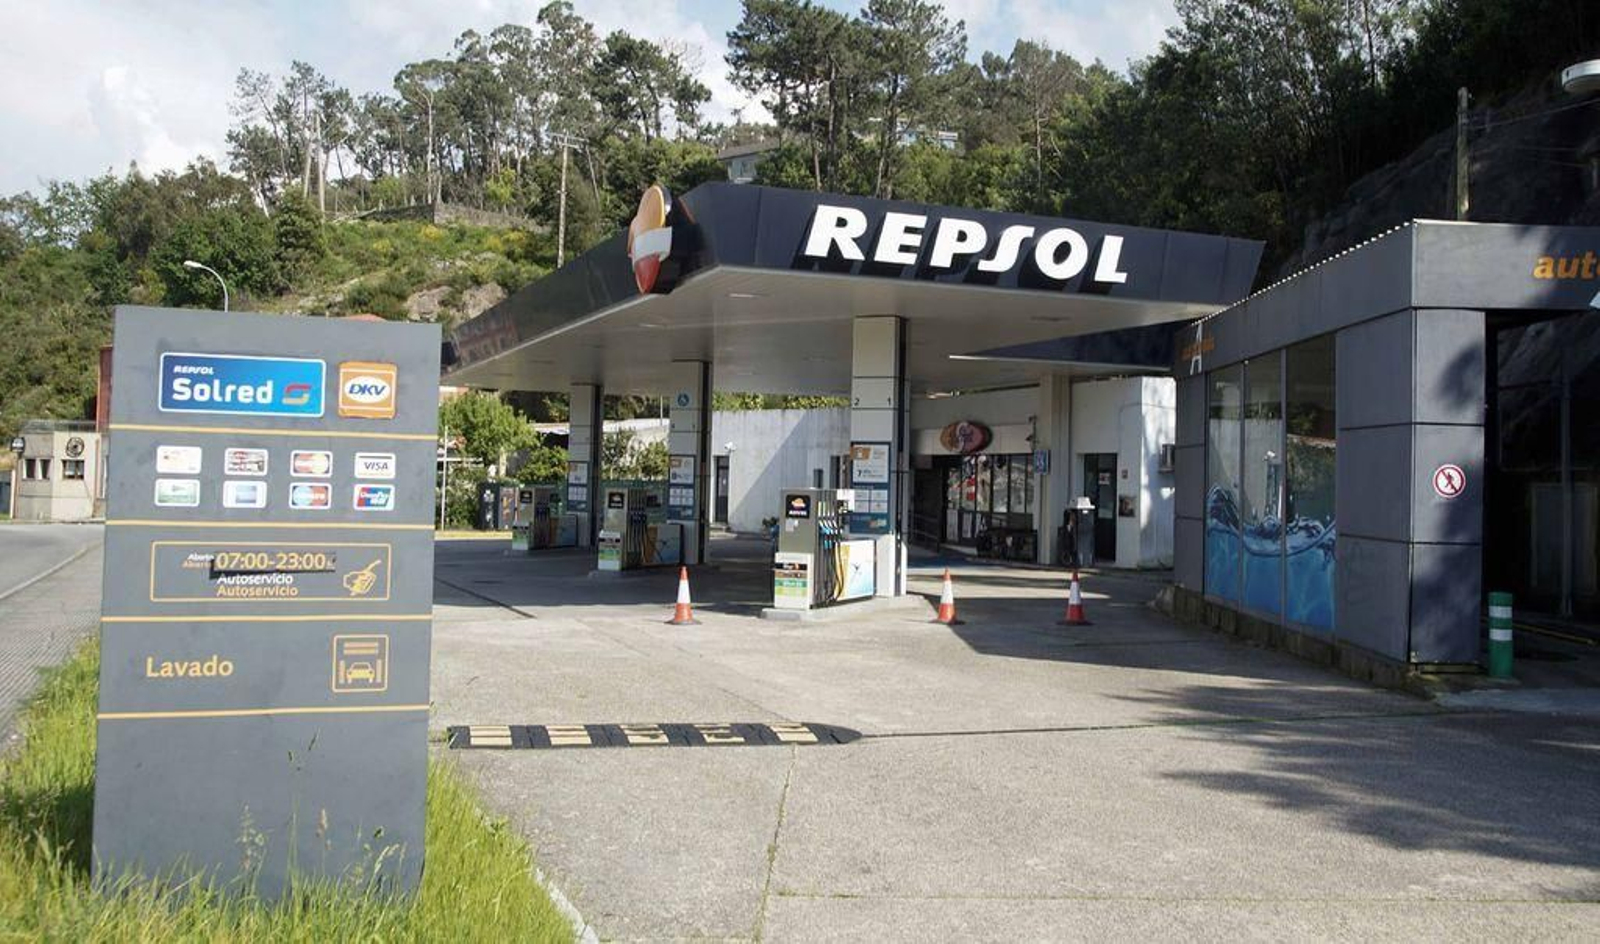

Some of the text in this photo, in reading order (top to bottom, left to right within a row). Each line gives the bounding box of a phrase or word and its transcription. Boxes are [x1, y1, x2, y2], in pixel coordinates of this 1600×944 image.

[804, 204, 1128, 284] REPSOL
[1533, 249, 1600, 279] aut
[173, 365, 214, 375] REPSOL
[172, 378, 274, 404] Solred
[349, 383, 386, 396] DKV
[364, 462, 389, 470] VISA
[215, 552, 326, 570] 07:00-23:00
[216, 585, 299, 597] Autoservicio
[146, 654, 234, 677] Lavado
